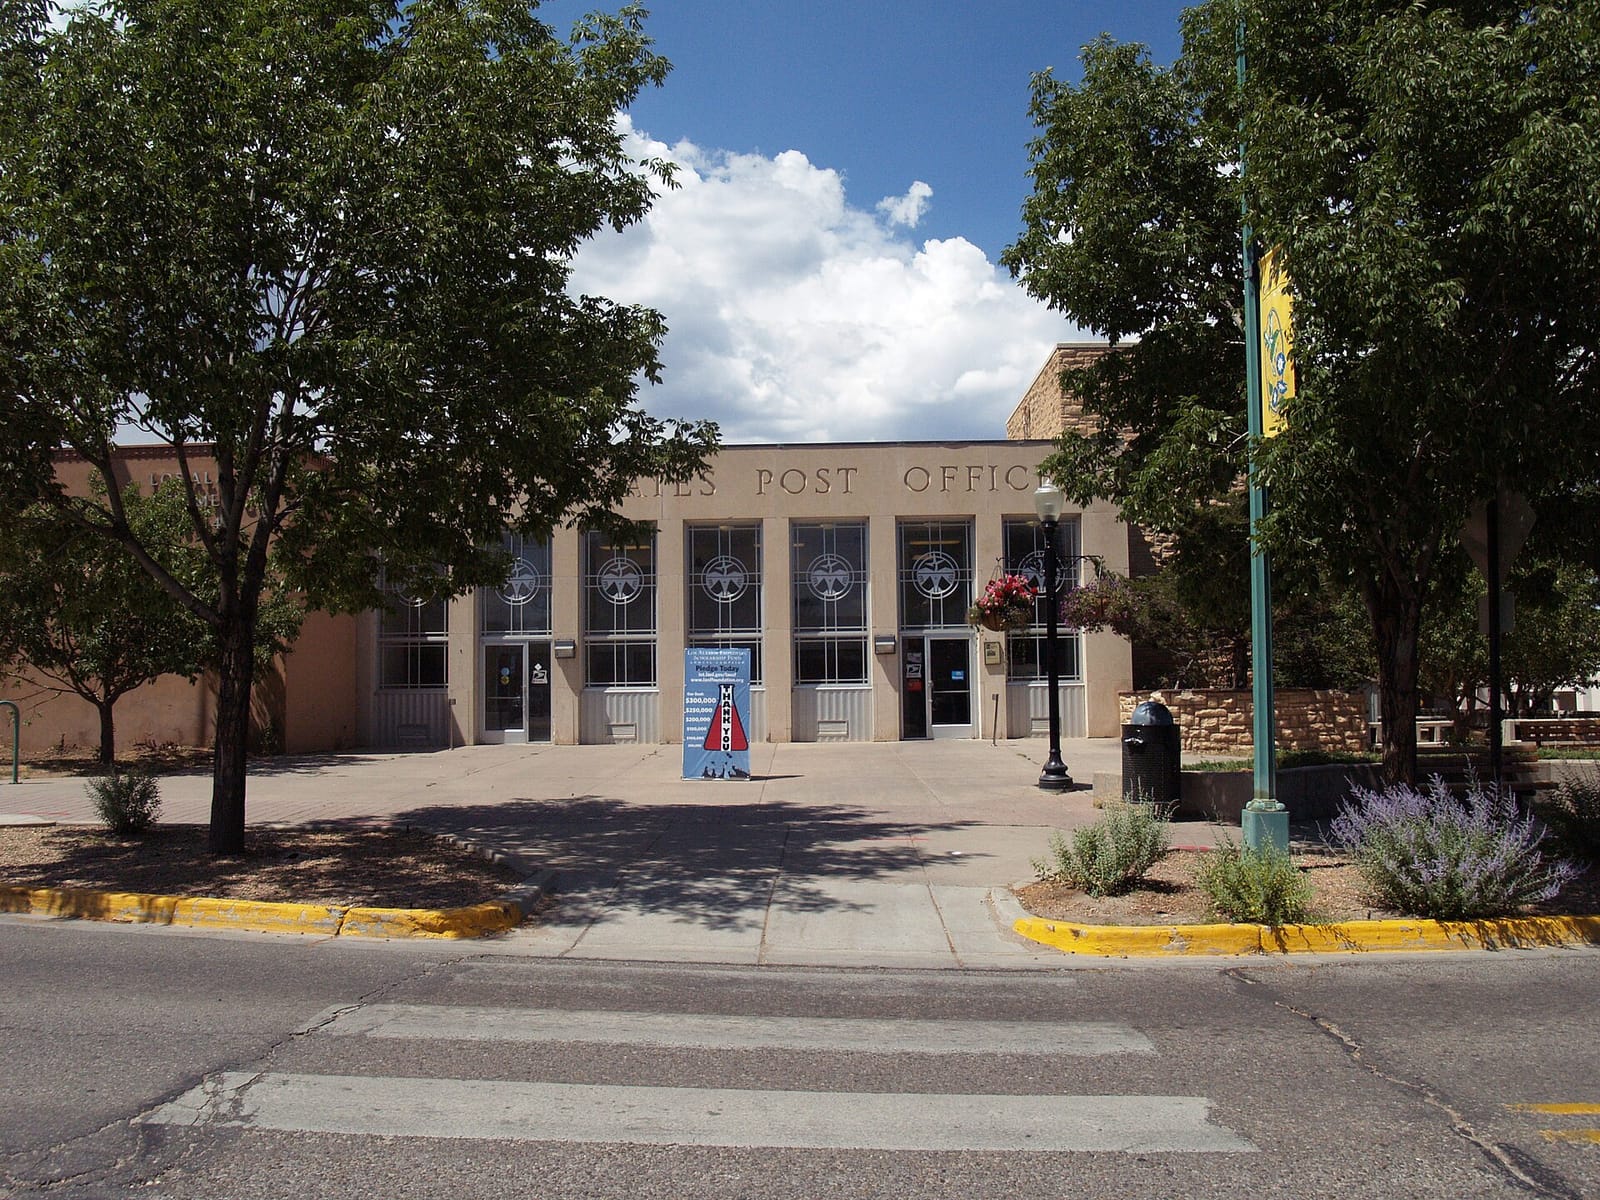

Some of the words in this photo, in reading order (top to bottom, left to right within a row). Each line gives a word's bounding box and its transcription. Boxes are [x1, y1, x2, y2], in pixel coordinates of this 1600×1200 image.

[756, 467, 859, 496] POST
[722, 685, 731, 724] THANK
[722, 727, 730, 751] YOU
